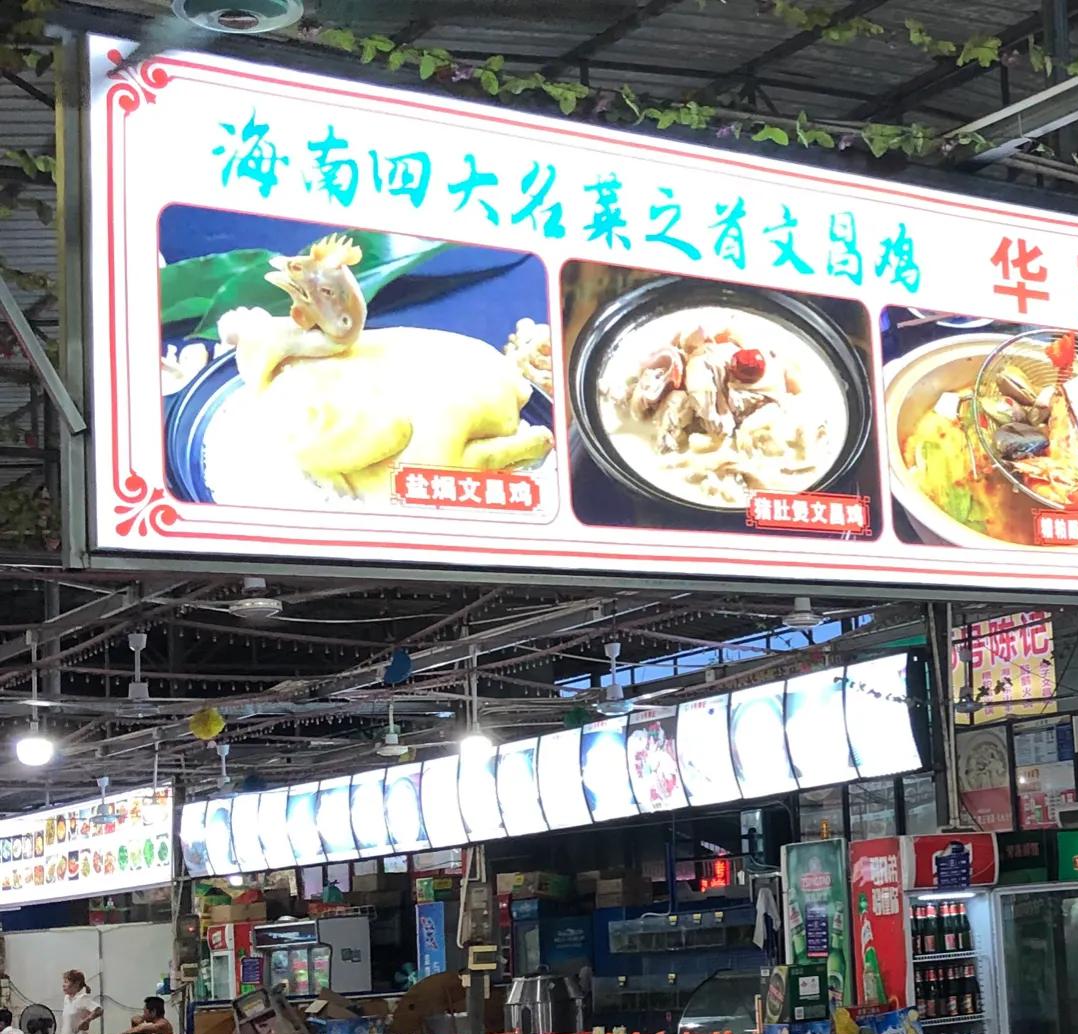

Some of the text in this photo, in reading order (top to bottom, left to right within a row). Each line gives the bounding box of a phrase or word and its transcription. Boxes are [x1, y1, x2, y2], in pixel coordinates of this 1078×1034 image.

[211, 108, 922, 294] 海南四大名菜之首文昌鸡
[405, 473, 533, 507] 盐焗文昌鸡
